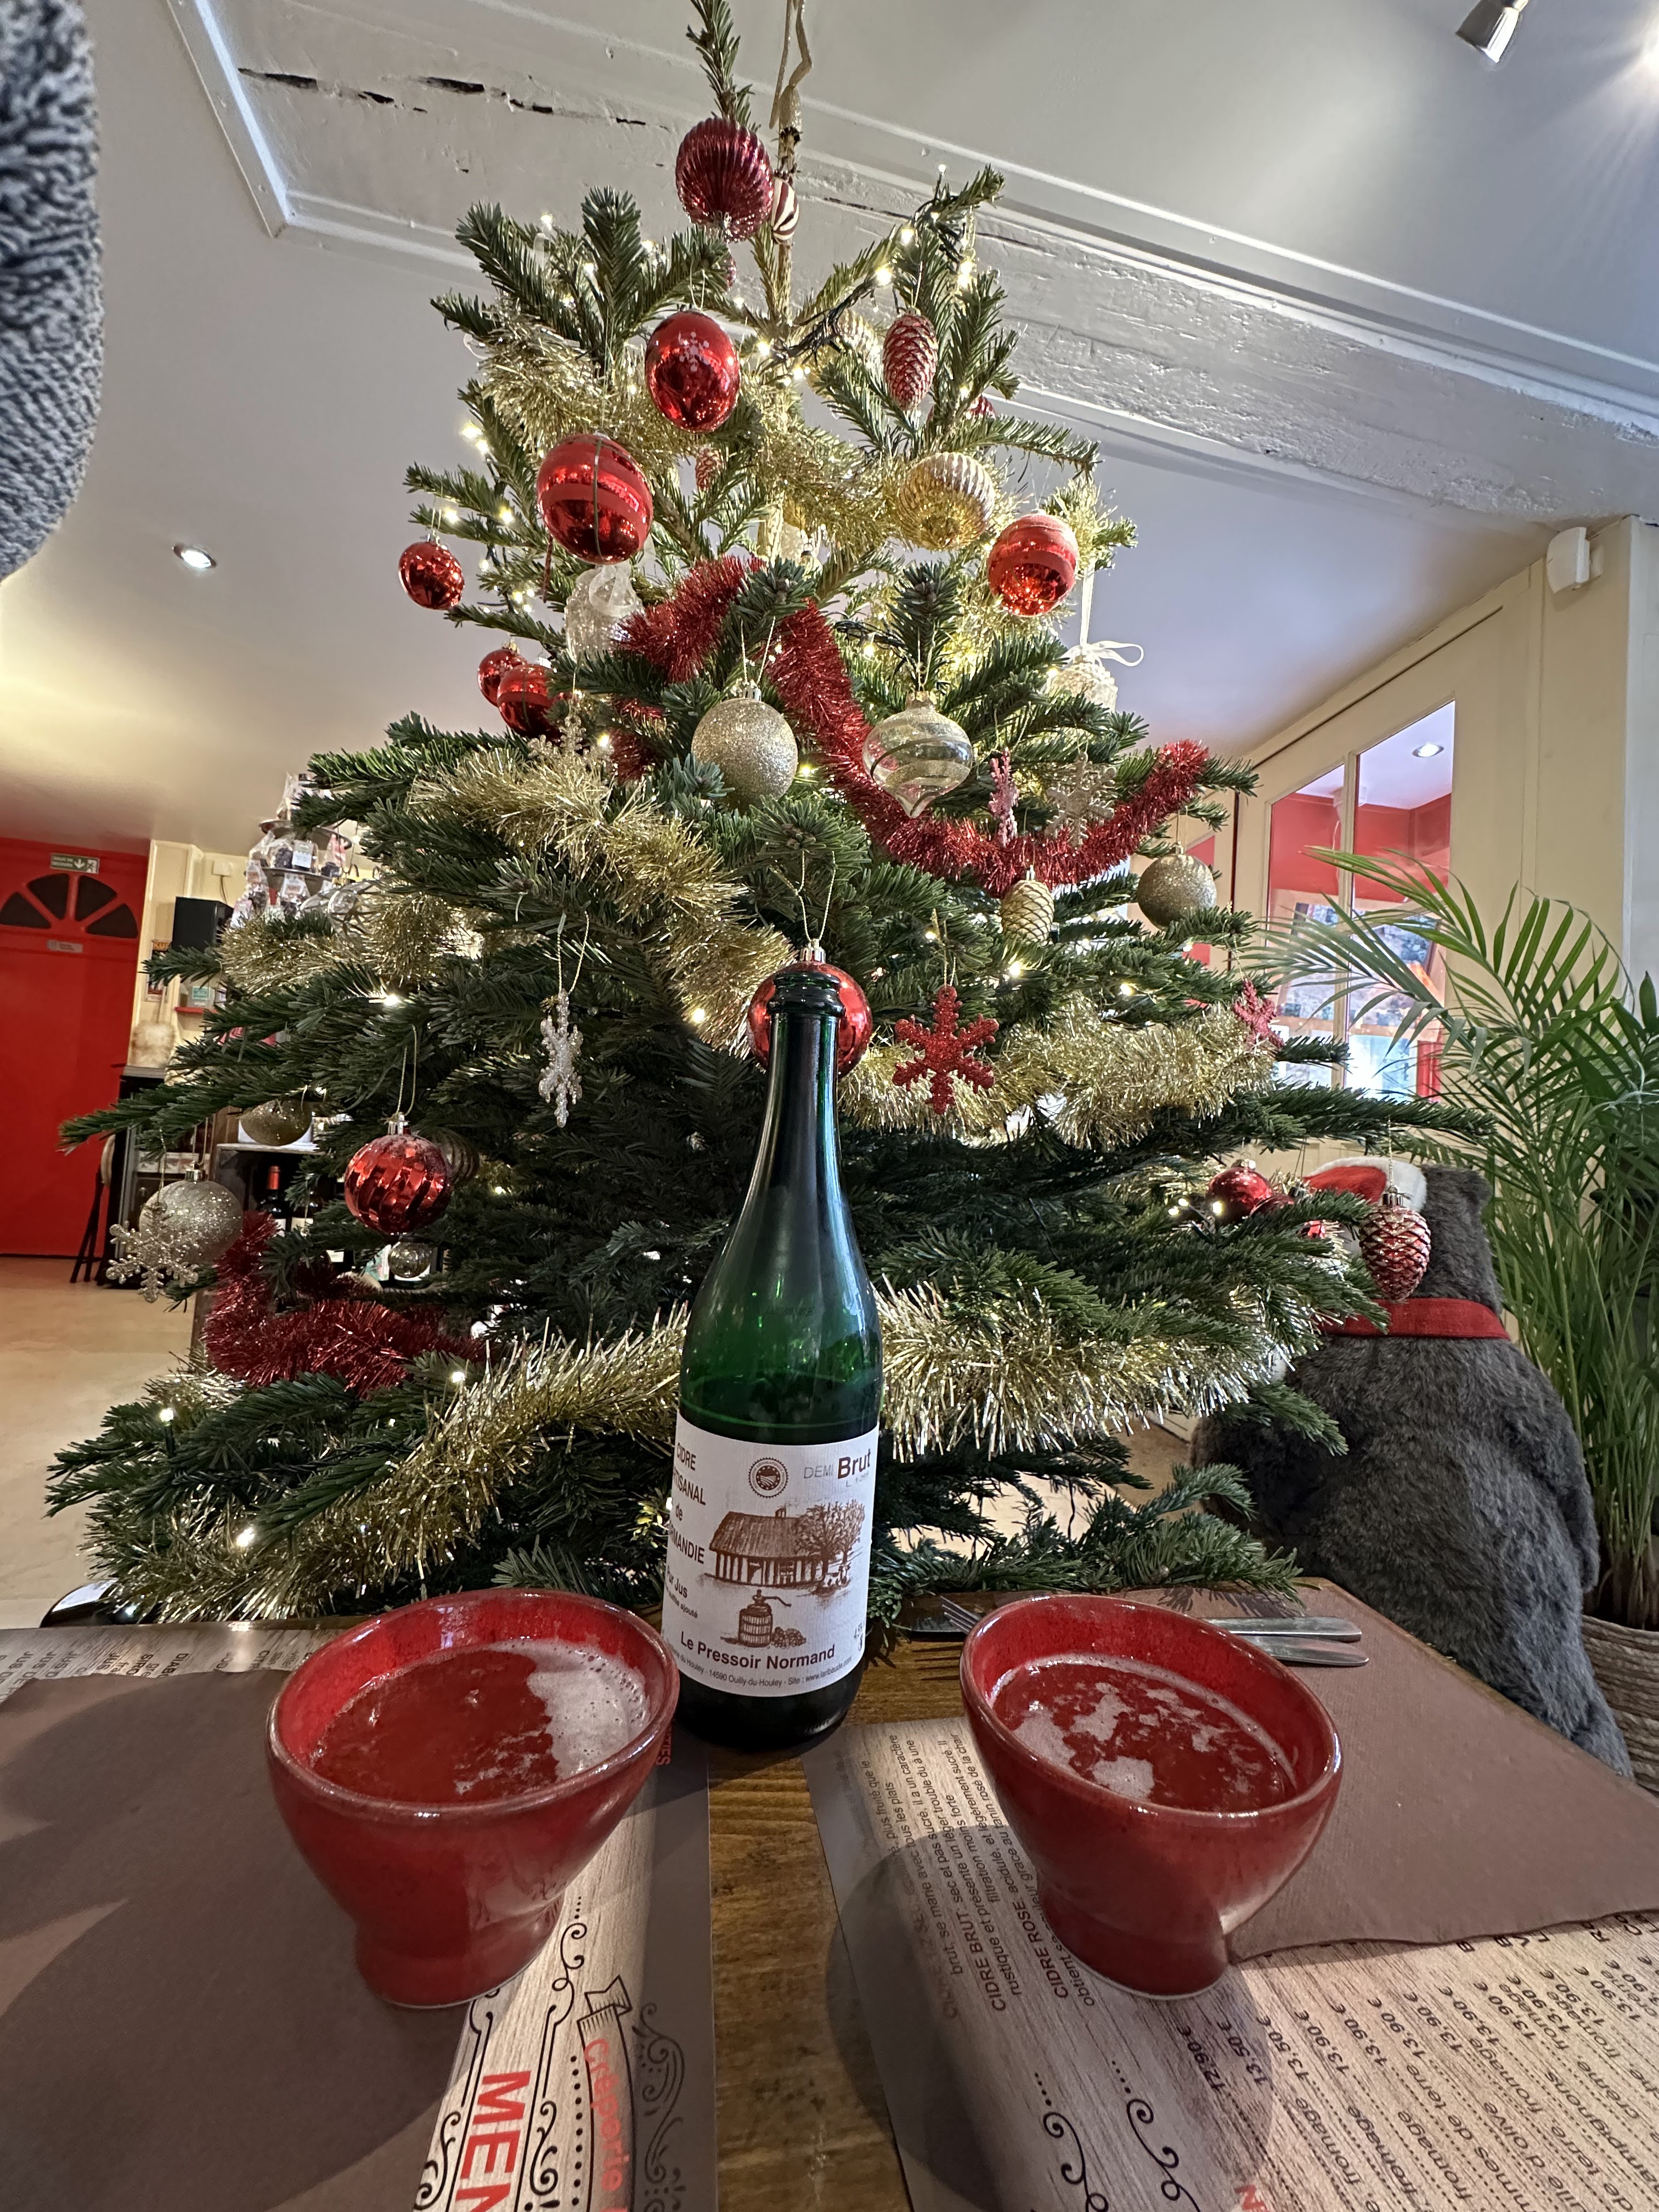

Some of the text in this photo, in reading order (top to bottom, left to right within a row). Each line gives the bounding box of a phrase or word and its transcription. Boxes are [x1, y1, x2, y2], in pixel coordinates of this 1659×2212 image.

[676, 1442, 696, 1471] CIDRE
[804, 1464, 833, 1479] DEMI
[838, 1448, 871, 1479] Brut
[675, 1503, 683, 1521] de
[674, 1578, 687, 1599] Jus
[680, 1602, 698, 1618] ajouté
[8, 1651, 34, 1669] JUS
[32, 1651, 57, 1669] JUS
[126, 1654, 154, 1675] SIRO
[156, 1653, 189, 1678] DIAB
[681, 1631, 693, 1650] Le
[698, 1641, 761, 1669] Pressoir
[766, 1644, 835, 1669] Normand
[709, 1669, 727, 1681] 14590
[889, 1735, 912, 1775] caractère
[906, 1740, 919, 1756] une
[951, 1734, 967, 1753] chair
[862, 1760, 870, 1769] le
[917, 1766, 928, 1778] du
[962, 1756, 971, 1764] la
[967, 1765, 979, 1778] de
[865, 1771, 879, 1788] que
[885, 1782, 903, 1805] plats
[905, 1776, 917, 1789] un
[974, 1780, 990, 1801] rosé
[869, 1790, 887, 1815] fruité
[923, 1780, 943, 1813] trouble
[955, 1776, 988, 1832] légèrement
[881, 1816, 897, 1839] plus
[894, 1807, 907, 1824] les
[919, 1808, 938, 1839] sucré,
[938, 1815, 955, 1844] léger
[986, 1804, 1005, 1829] tanin
[900, 1825, 916, 1848] tous
[946, 1795, 1001, 1904] filtration moins forte
[950, 1845, 963, 1859] un
[981, 1833, 995, 1845] et
[999, 1831, 1013, 1846] au
[910, 1849, 928, 1878] avec
[932, 1842, 950, 1864] pas
[939, 1866, 953, 1878] et
[992, 1848, 1018, 1894] acidulé,
[922, 1882, 943, 1918] marie
[947, 1881, 963, 1904] sec
[958, 1863, 991, 1917] présente
[936, 1921, 949, 1938] se
[980, 1920, 994, 1933] et
[989, 1937, 1022, 1996] rustique
[1035, 1948, 1069, 1999] CIDRE
[1060, 1955, 1095, 2006] obtient
[975, 1957, 1006, 2012] CIDRE
[1600, 1970, 1658, 2017] crème
[1499, 1983, 1570, 2050] fromage
[1522, 1989, 1571, 2033] 13,90
[1555, 1983, 1605, 2027] 13,90
[1591, 1980, 1641, 2022] 13,90
[1417, 2006, 1463, 2052] 13,90
[1453, 2001, 1500, 2046] 13,90
[1488, 1996, 1536, 2040] 13,90
[1547, 1991, 1621, 2058] fromage
[1307, 2025, 1349, 2075] 13,90
[1344, 2019, 1387, 2067] 13,90
[1381, 2012, 1426, 2059] 13,90
[1187, 2041, 1226, 2092] 12,90
[1228, 2036, 1268, 2085] 13,50
[1268, 2031, 1310, 2081] 13,50
[1406, 2064, 1447, 2109] terre
[1576, 2055, 1639, 2119] crème,
[1448, 2114, 1473, 2140] de
[1470, 2038, 1634, 2211] de terre, fromage
[1483, 2102, 1545, 2168] d'olive
[455, 2070, 532, 2212] MEN
[1295, 2097, 1361, 2186] fromage
[1348, 2105, 1418, 2194] fromage
[1397, 2111, 1474, 2200] fromage
